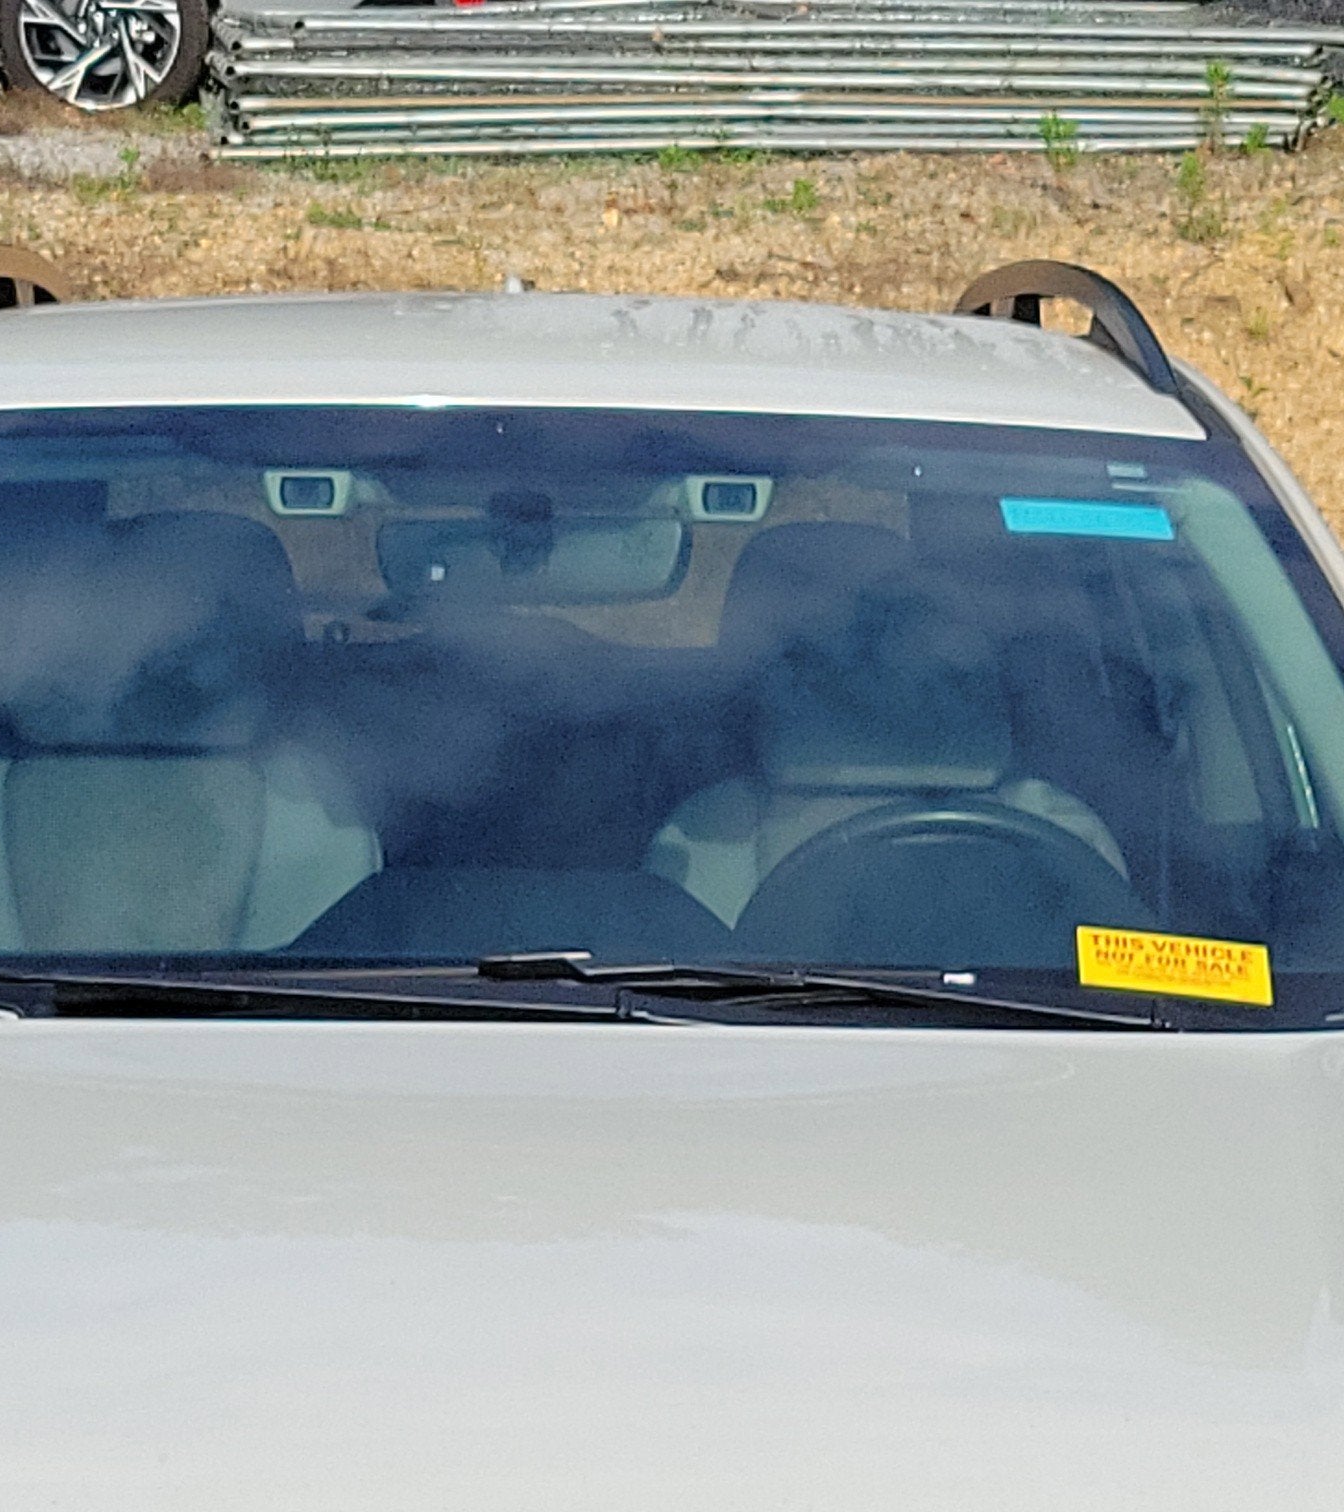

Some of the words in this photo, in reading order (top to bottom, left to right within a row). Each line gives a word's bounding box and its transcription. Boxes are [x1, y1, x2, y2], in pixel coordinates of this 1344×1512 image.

[1091, 933, 1144, 950] THIS
[1151, 940, 1253, 963] VEHICLE
[1095, 949, 1135, 962] NOT
[1145, 953, 1187, 969] FOR
[1196, 960, 1251, 976] SALE
